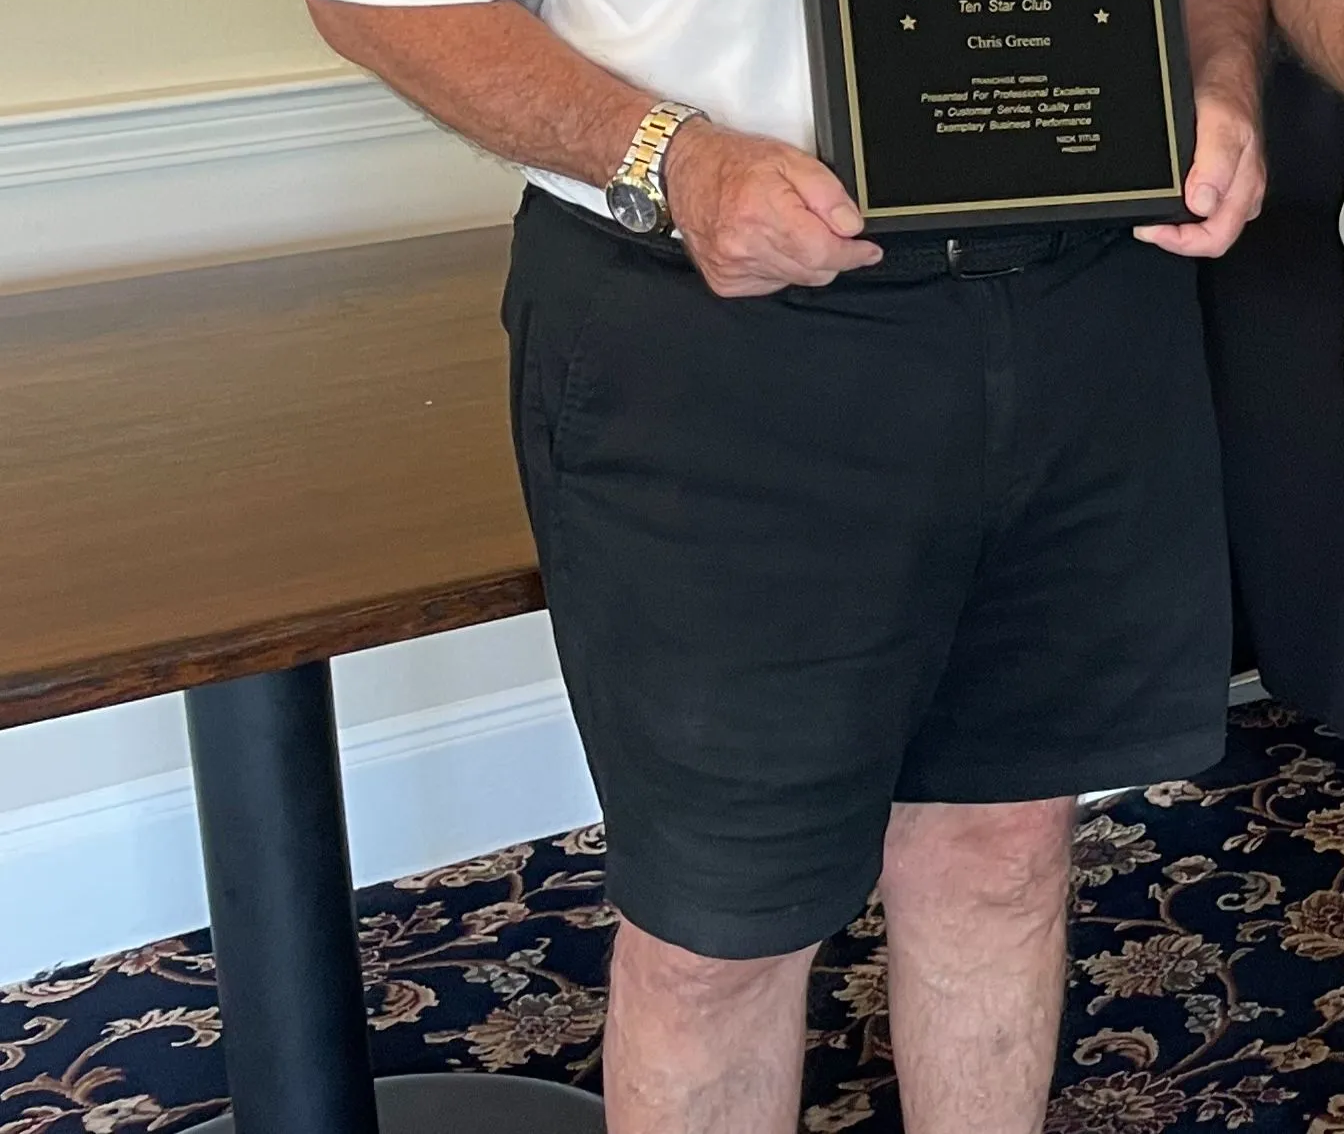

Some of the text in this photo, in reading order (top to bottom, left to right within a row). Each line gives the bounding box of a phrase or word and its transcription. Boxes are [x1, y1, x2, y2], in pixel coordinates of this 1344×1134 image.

[959, 0, 981, 12] Ten
[989, 0, 1015, 12] Star
[968, 35, 1050, 49] Chris Greene
